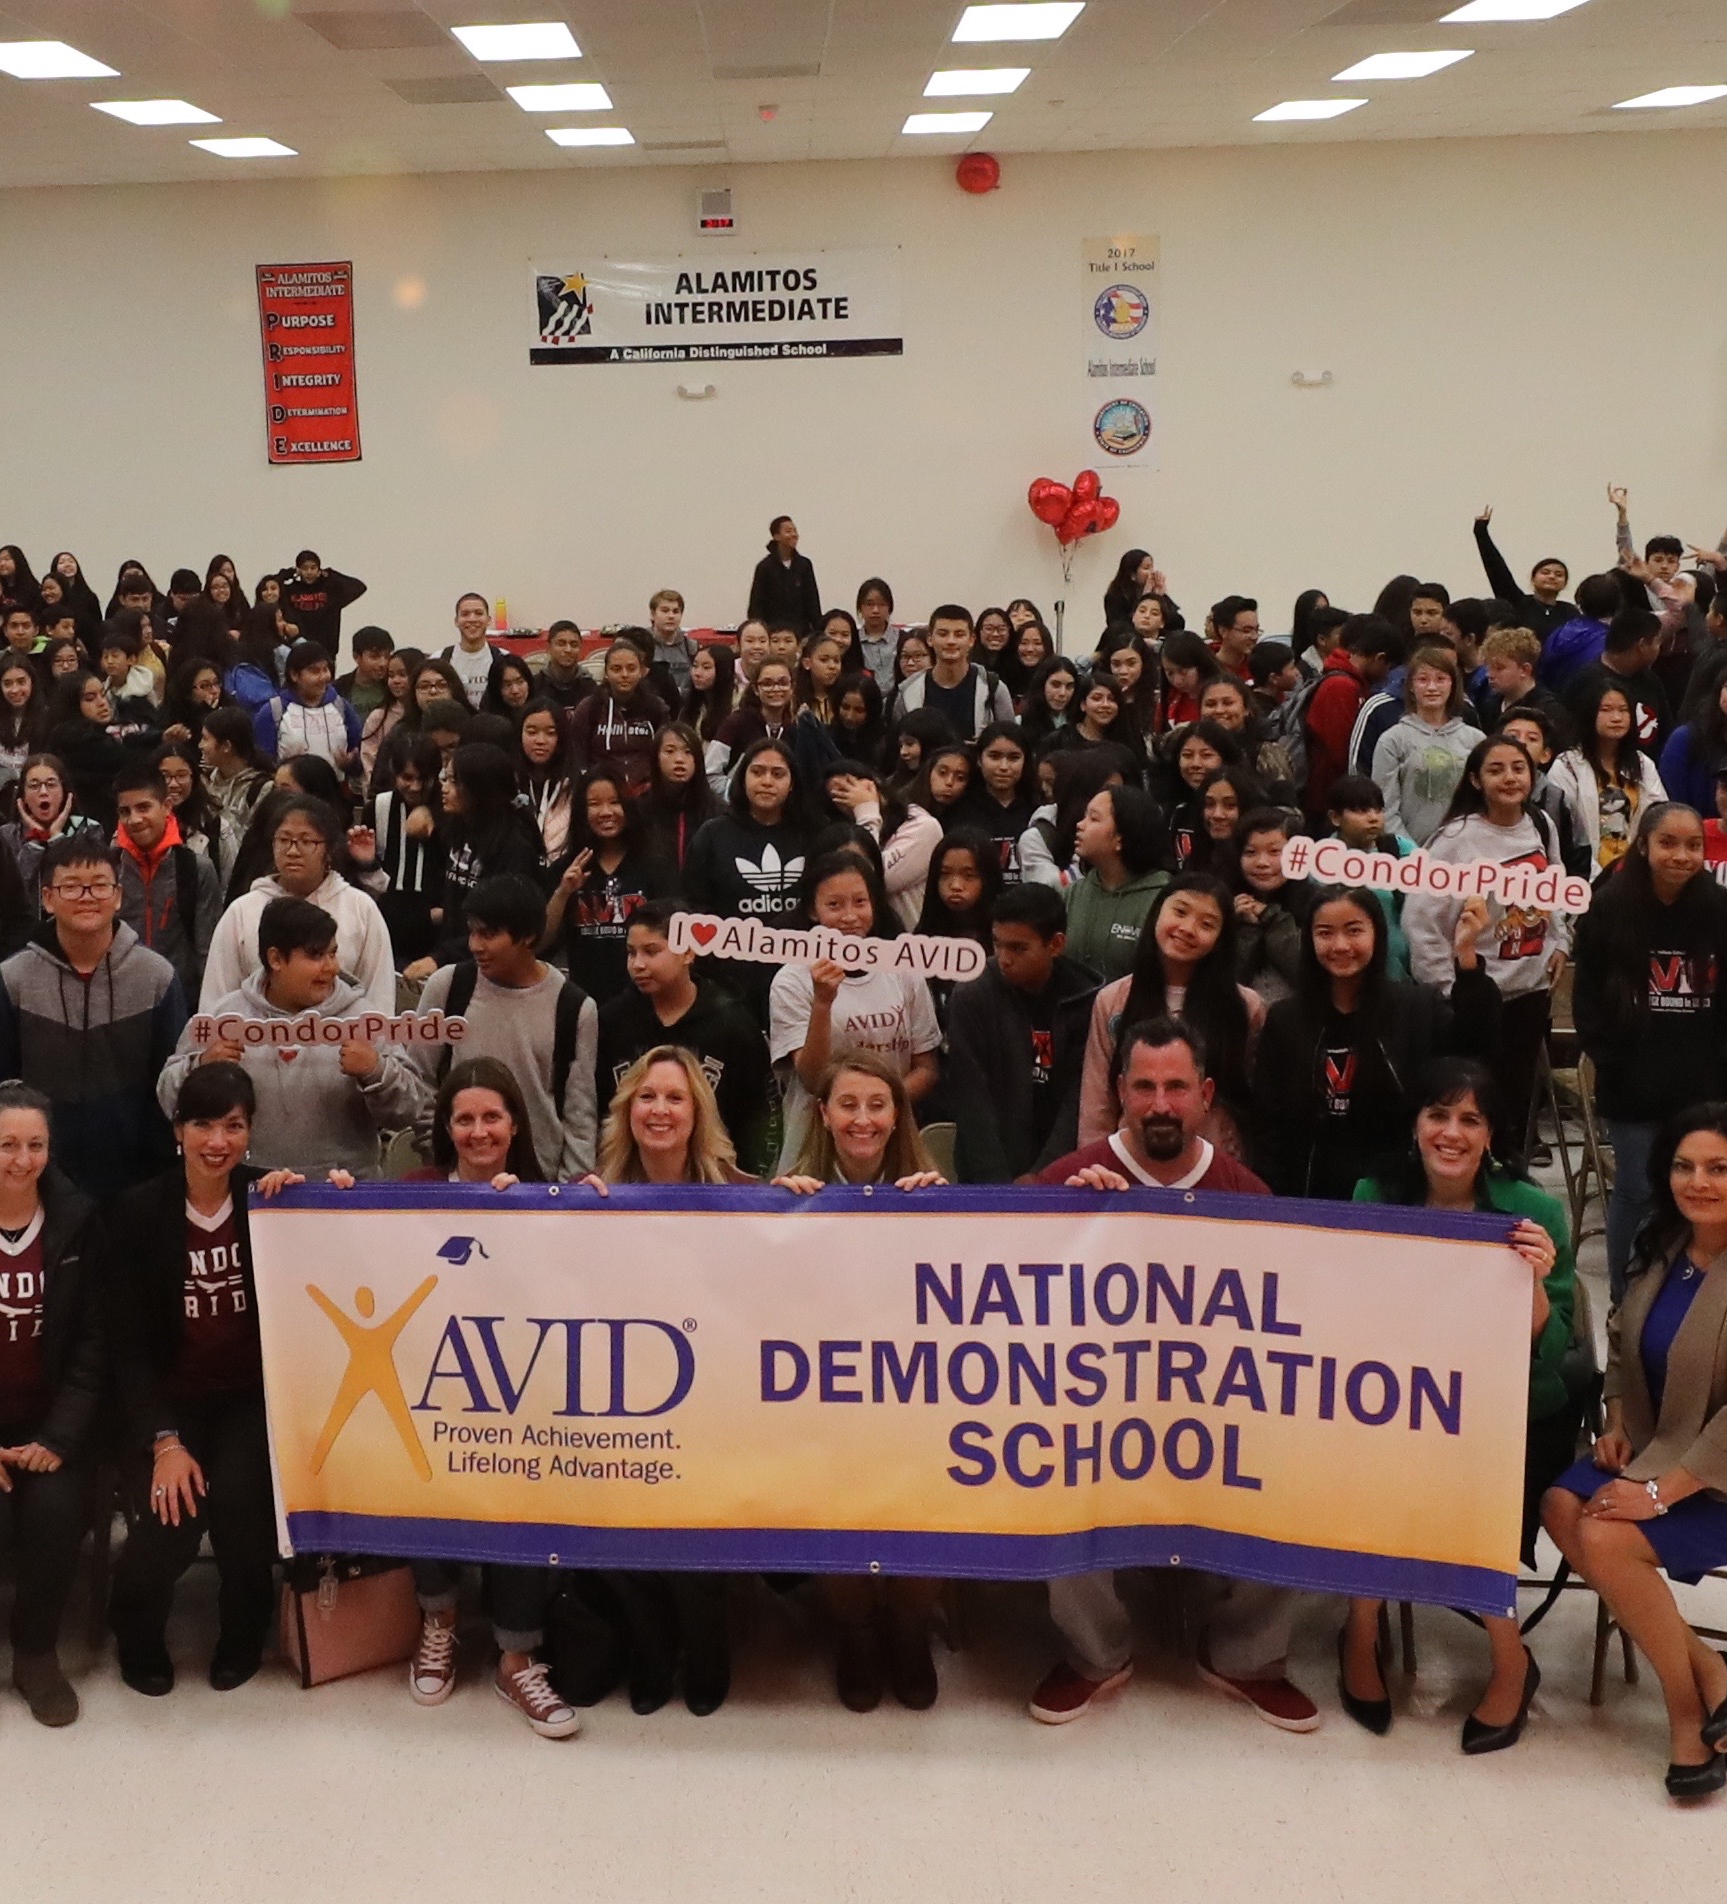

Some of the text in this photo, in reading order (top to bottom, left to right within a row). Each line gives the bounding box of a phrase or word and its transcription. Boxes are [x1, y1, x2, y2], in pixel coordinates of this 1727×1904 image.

[1107, 248, 1136, 259] 2017
[1089, 261, 1155, 273] Title School
[278, 272, 333, 285] ALAMITOS
[675, 268, 818, 295] ALAMITOS
[266, 285, 345, 298] INTERMEDIATE
[266, 312, 334, 330] PURPOSE
[645, 297, 850, 325] INTERMEDIATE
[268, 343, 346, 362] RESPONSIBILITY
[610, 343, 827, 361] A California Distinguished School
[273, 373, 342, 391] INTEGRITY
[272, 404, 348, 424] DETERMINATION
[274, 437, 352, 455] EXCELLENCE
[1288, 843, 1585, 907] #CondorPride
[738, 894, 802, 913] adida
[676, 921, 979, 974] I Alamitos AVID
[194, 1015, 465, 1044] #CondorPride
[844, 1012, 896, 1032] AVID
[914, 1262, 1303, 1337] NATIONAL
[410, 1314, 696, 1417] AVID
[759, 1339, 1463, 1436] DEMONSTRATION
[433, 1421, 682, 1450] Proven Achievement.
[946, 1416, 1264, 1492] SCHOOL
[447, 1451, 682, 1485] Lifelong Advantage.
